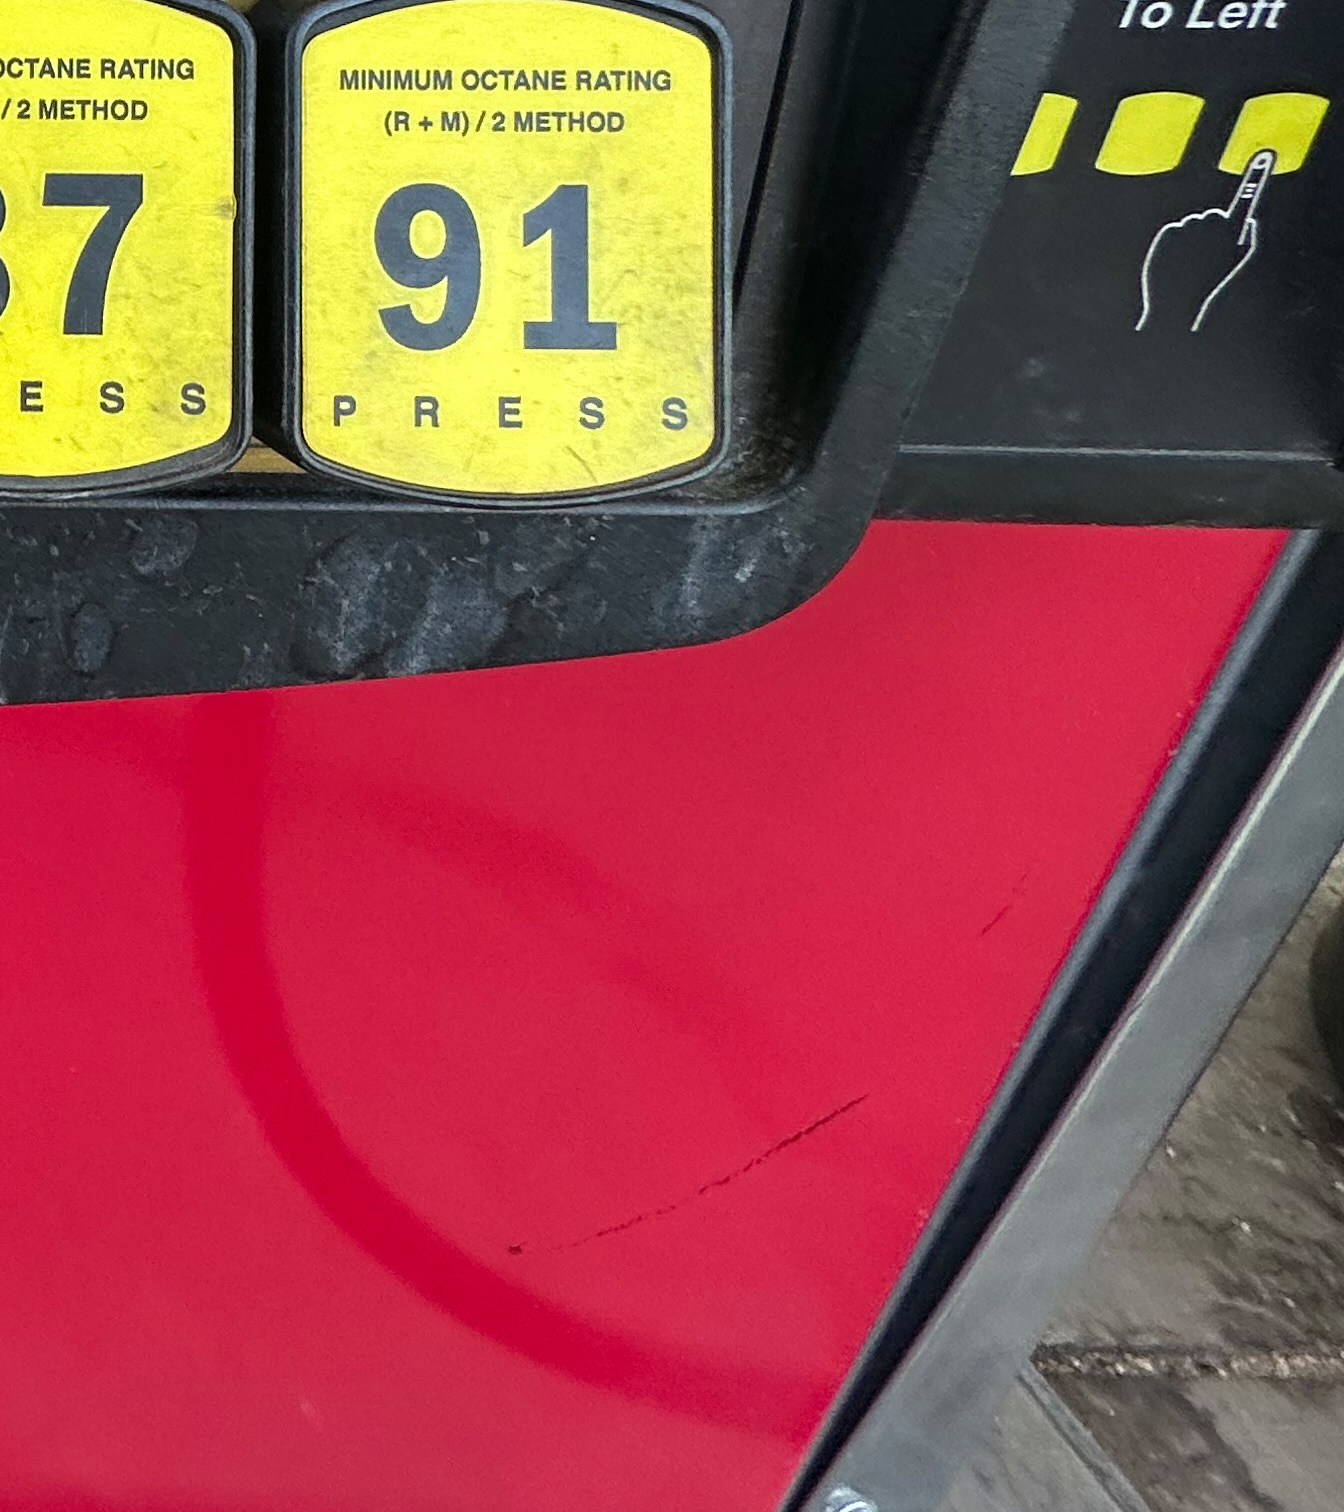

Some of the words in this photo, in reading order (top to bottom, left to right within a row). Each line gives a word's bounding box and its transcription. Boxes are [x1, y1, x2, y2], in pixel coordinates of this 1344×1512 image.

[101, 58, 194, 81] RATING
[339, 69, 453, 91] MINIMUM
[461, 69, 567, 91] OCTANE
[576, 69, 671, 92] RATING
[17, 98, 30, 121] 2
[38, 98, 148, 122] METHOD
[492, 111, 505, 133] 2
[514, 111, 625, 133] METHOD
[374, 183, 618, 352] 91
